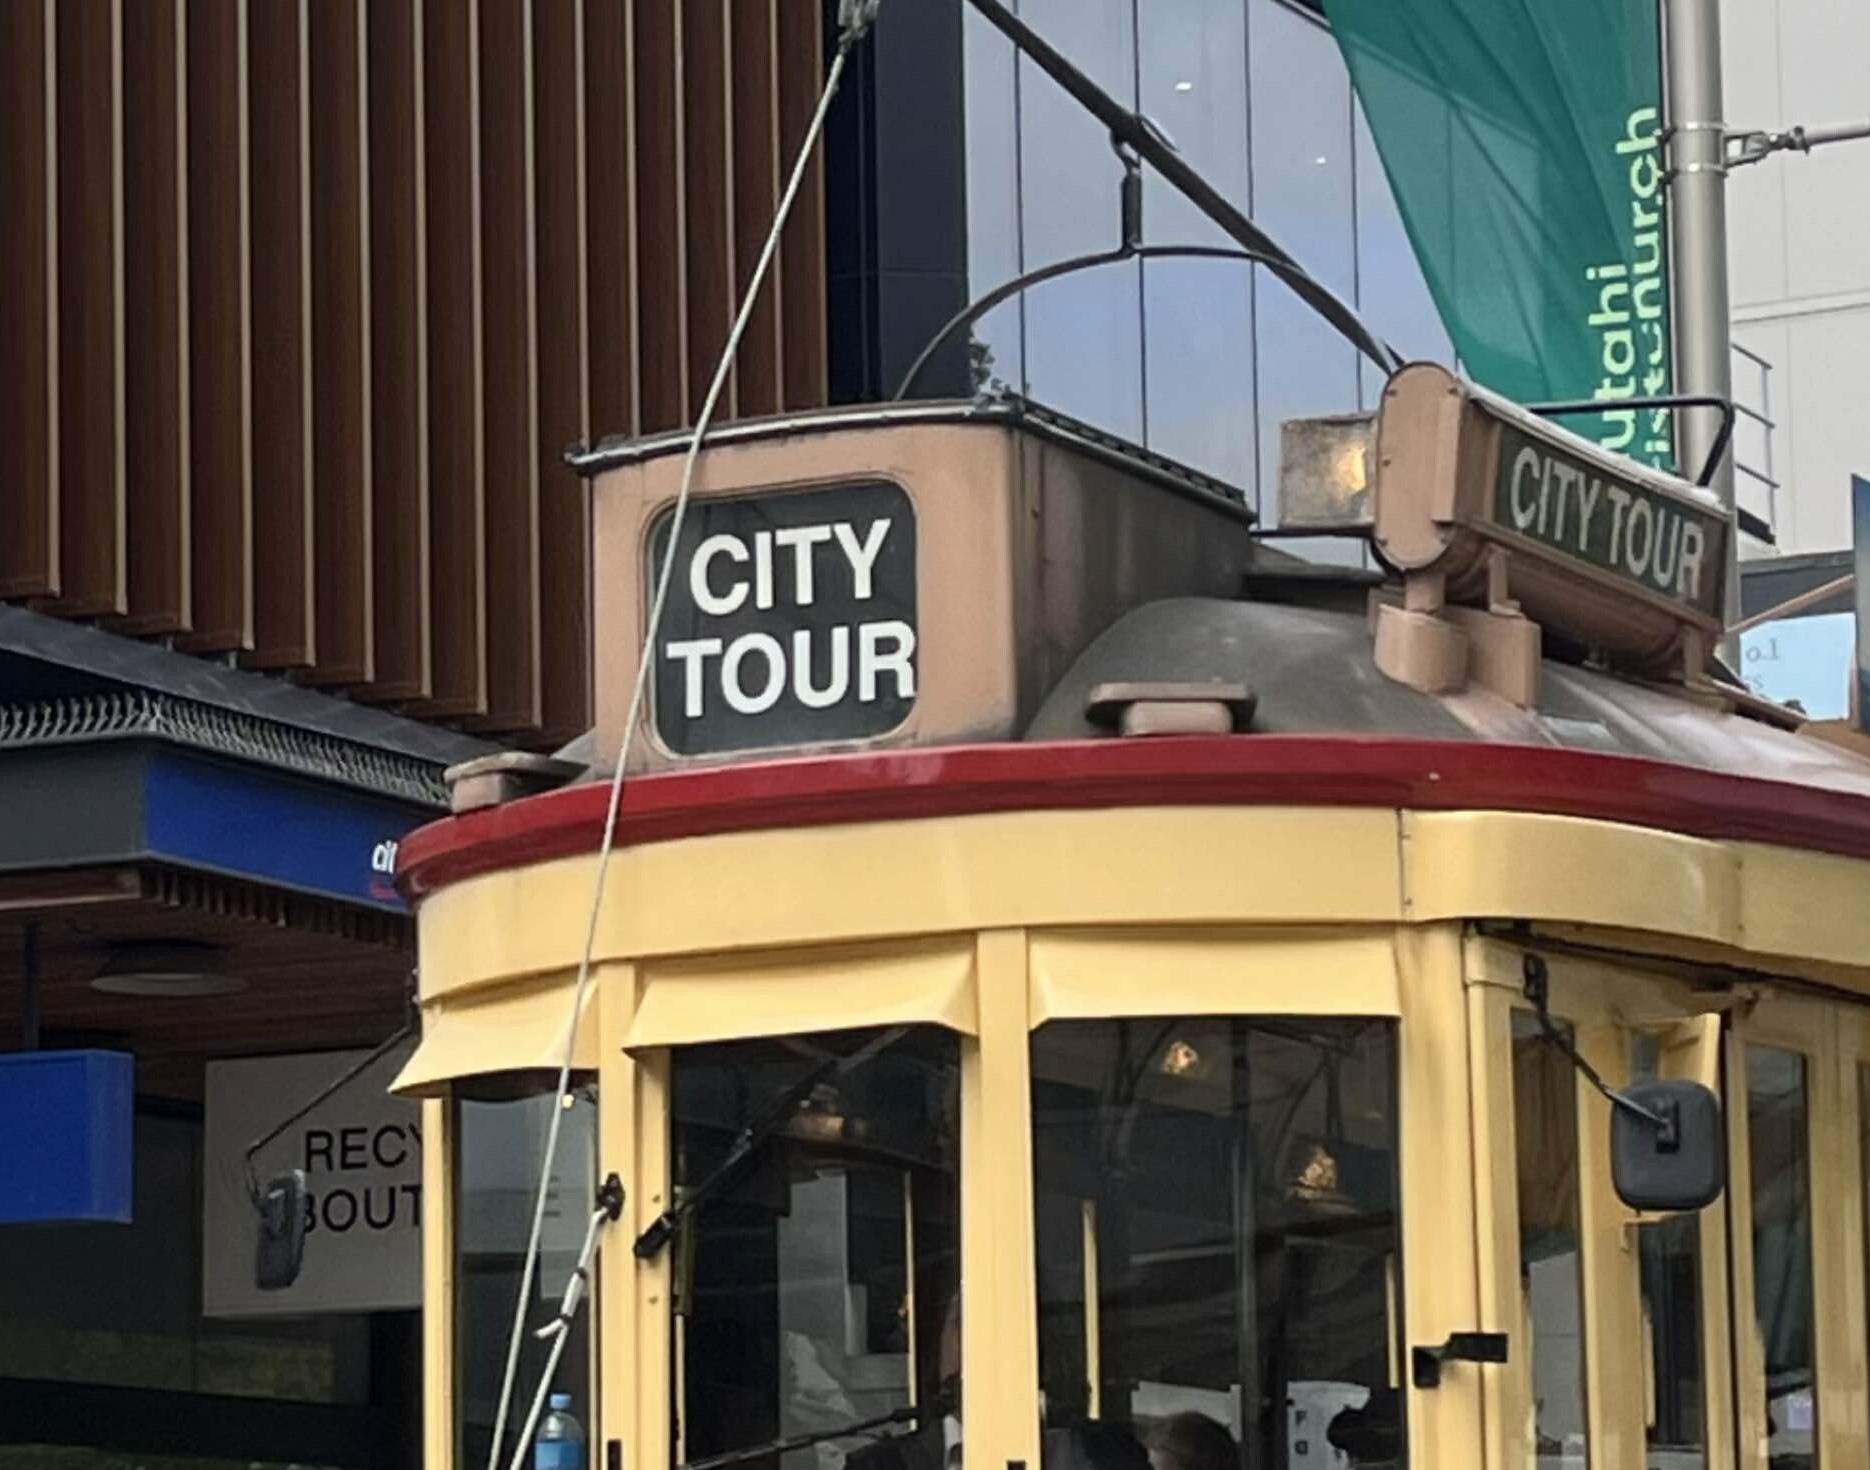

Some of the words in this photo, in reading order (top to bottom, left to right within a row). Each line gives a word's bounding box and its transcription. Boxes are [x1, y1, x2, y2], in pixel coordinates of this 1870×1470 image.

[690, 518, 891, 615] CITY
[1511, 447, 1601, 552] CITY
[1608, 485, 1704, 599] TOUR
[666, 620, 915, 717] TOUR
